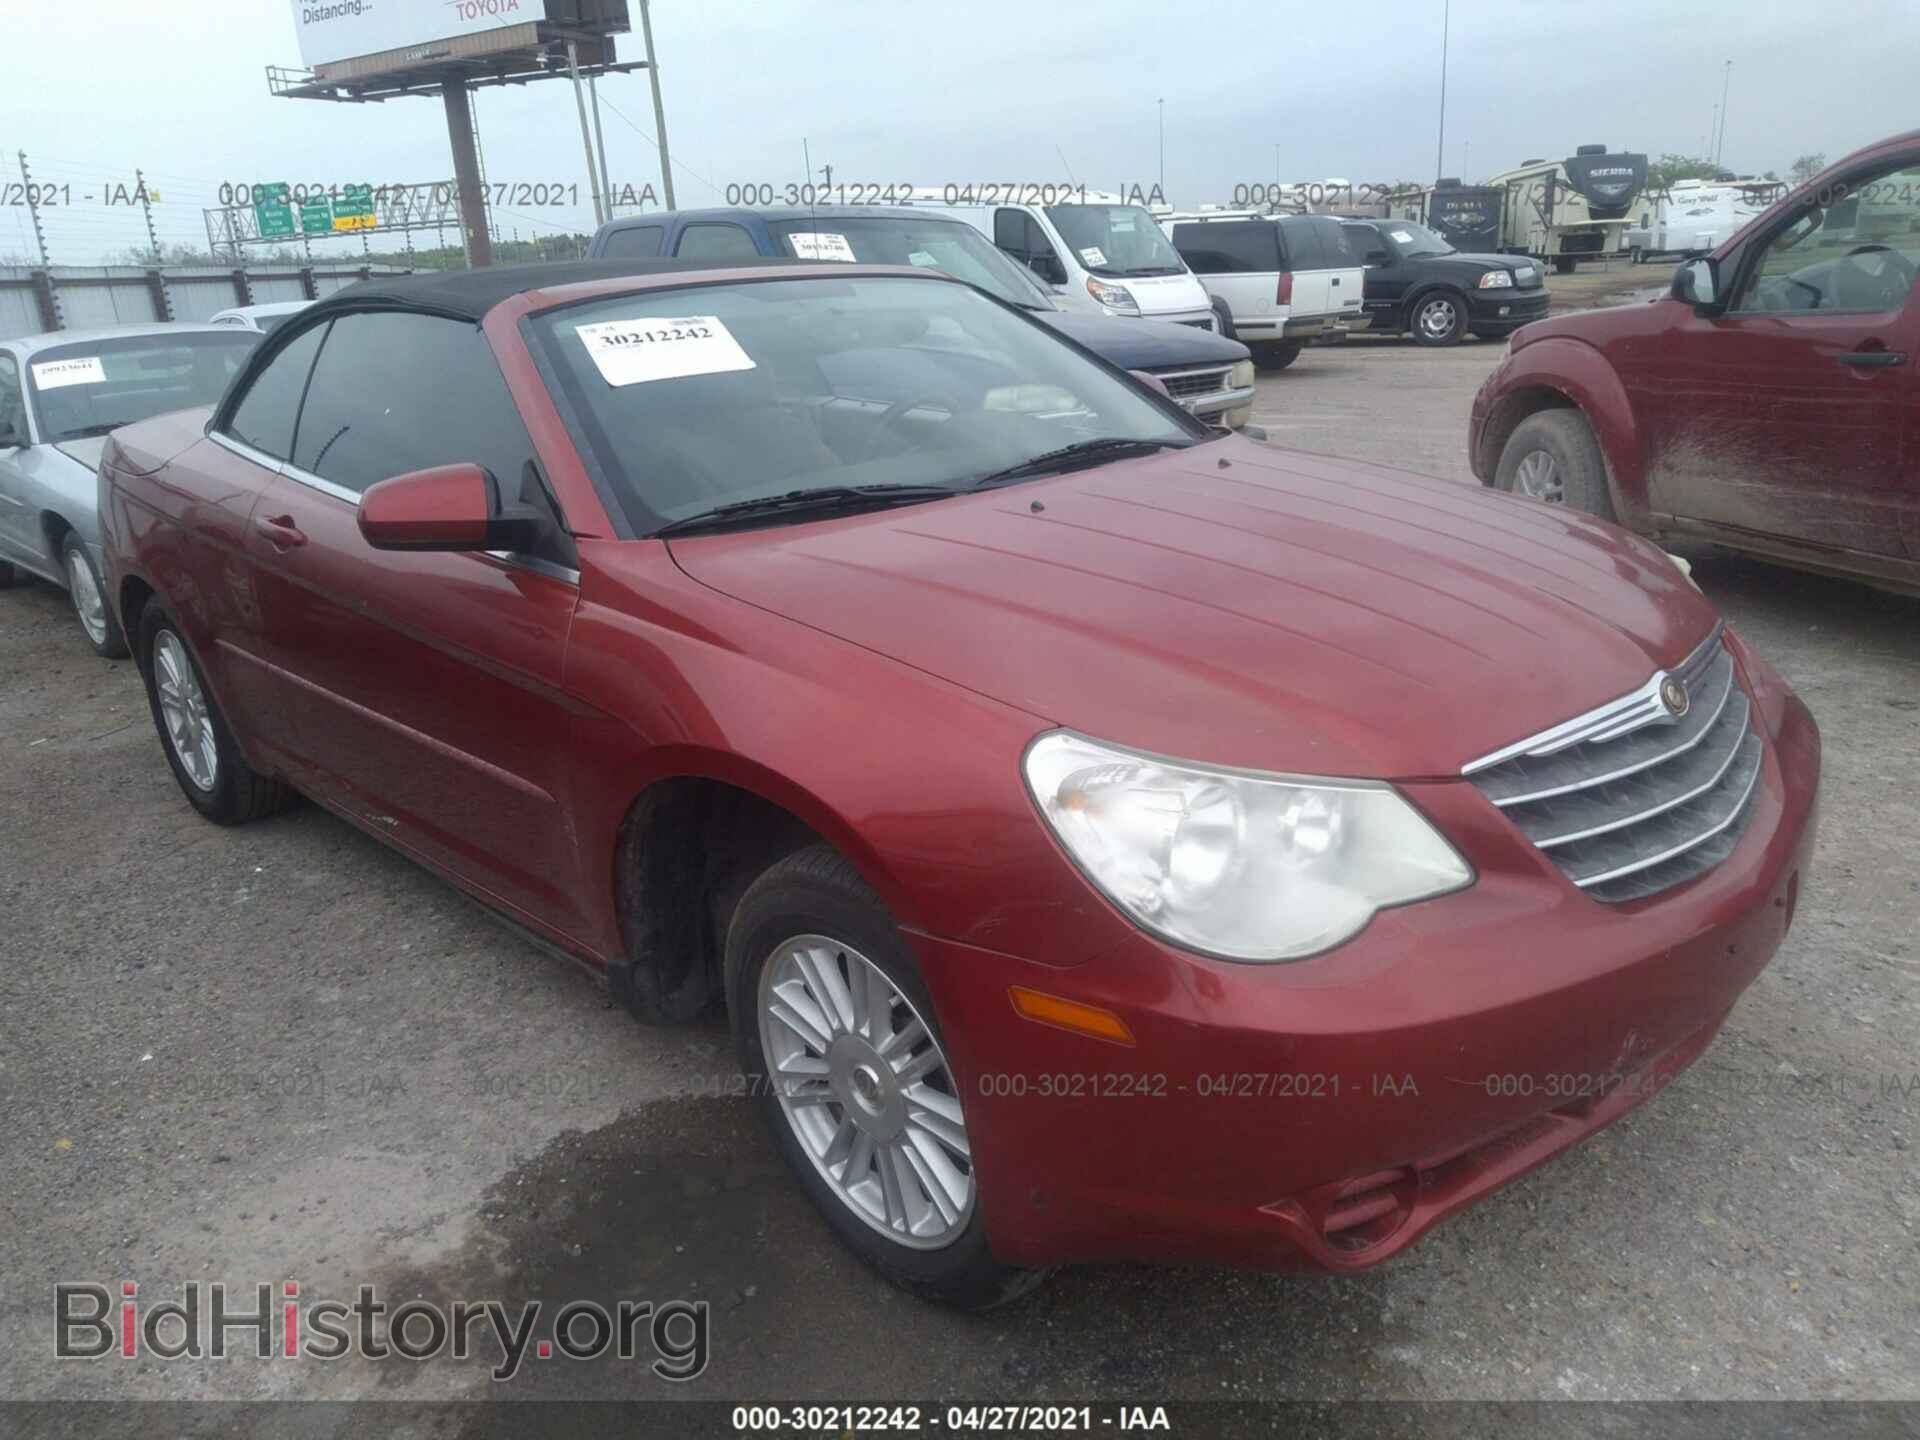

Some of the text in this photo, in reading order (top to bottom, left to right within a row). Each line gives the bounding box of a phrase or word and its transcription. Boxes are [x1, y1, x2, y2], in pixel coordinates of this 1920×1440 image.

[303, 3, 373, 25] Distancing...
[456, 0, 519, 22] TOYOTA
[600, 327, 713, 347] 30212242
